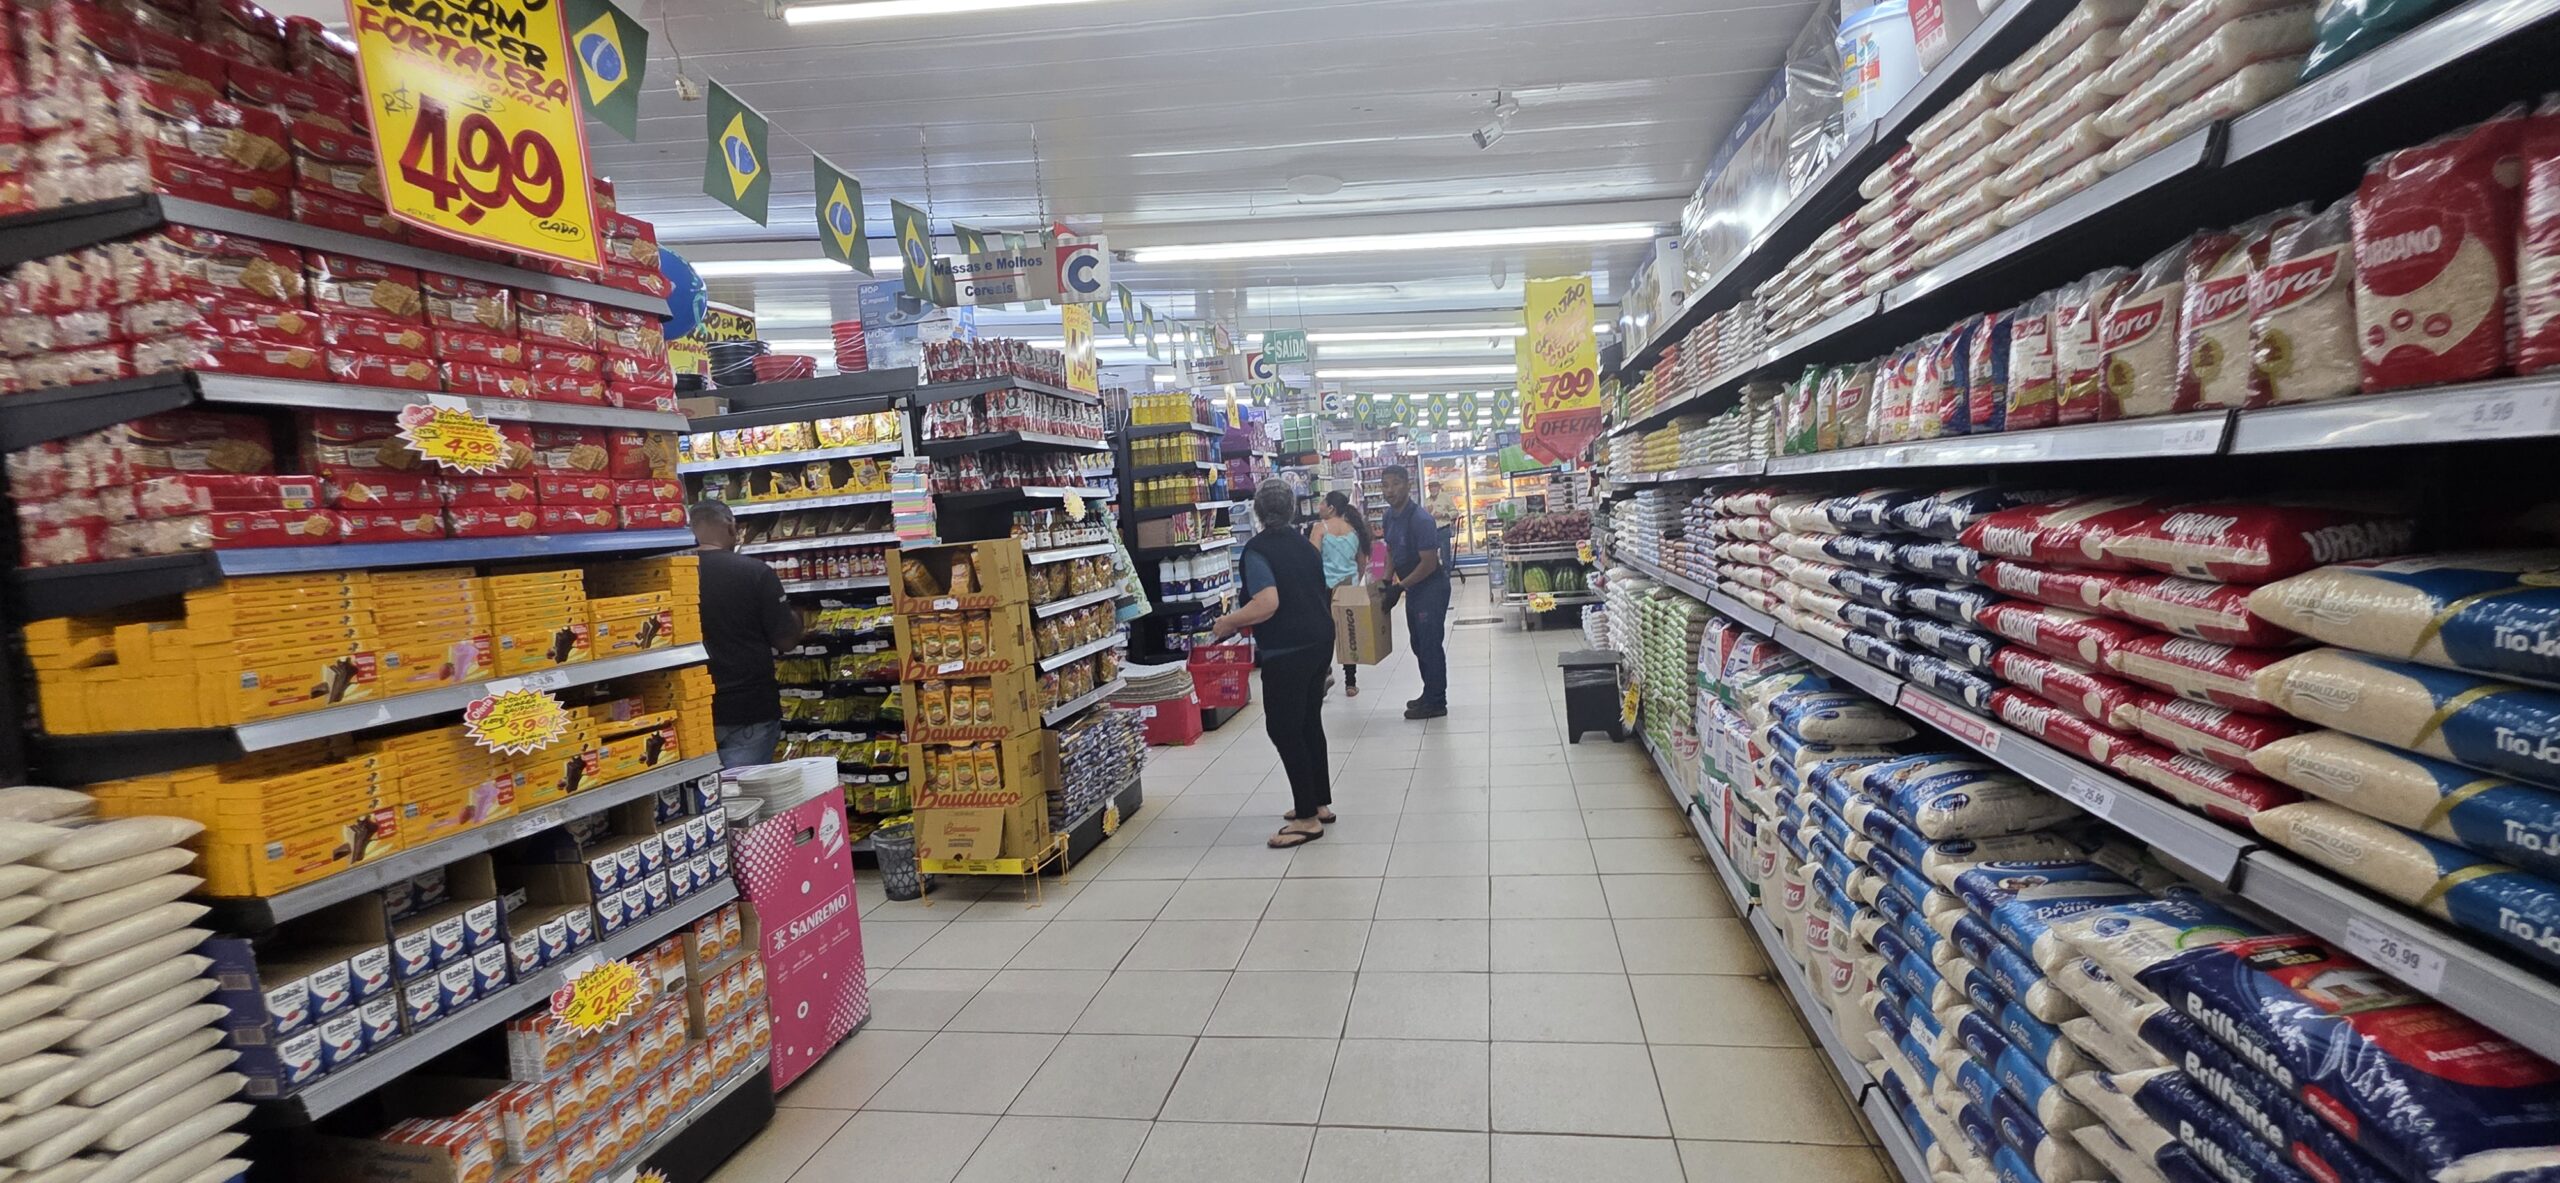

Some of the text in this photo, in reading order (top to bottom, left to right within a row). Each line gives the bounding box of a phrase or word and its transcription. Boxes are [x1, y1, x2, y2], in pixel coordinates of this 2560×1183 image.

[357, 5, 569, 108] FORTALEZA
[382, 80, 414, 118] R$
[398, 93, 565, 226] 4,99
[538, 221, 579, 237] CADA
[934, 256, 1043, 276] Massas e Molhos
[861, 286, 879, 294] MOP
[965, 283, 1014, 297] Cereais
[1275, 335, 1307, 359] SAÍDA
[1190, 359, 1224, 369] Limpeza
[1539, 367, 1595, 410] 7,99
[620, 436, 645, 446] LIANE
[1540, 416, 1601, 437] OFERTA
[444, 438, 497, 460] 4,99
[2160, 512, 2238, 538] URBANO
[1983, 524, 2039, 557] URBANO
[1345, 608, 1358, 651] COMIGO
[2494, 626, 2529, 652] Tio
[2284, 679, 2359, 704] PARBOILIZADO
[508, 716, 550, 737] 3,99
[908, 713, 1010, 744] Bauducco
[2003, 694, 2050, 736] URBANO
[2495, 727, 2531, 756] Tio
[2288, 756, 2362, 786] PARBOILIZADO
[913, 781, 1022, 809] Bauducco
[2291, 822, 2364, 859] PARBOILIZADO
[2503, 819, 2541, 851] Tio
[789, 893, 847, 940] SANREMO
[2500, 907, 2535, 942] Tio
[2380, 938, 2420, 969] 26,99
[2186, 991, 2294, 1090] Brilhante
[2237, 1022, 2271, 1049] ARROZ
[2185, 1050, 2285, 1149] Brilhante
